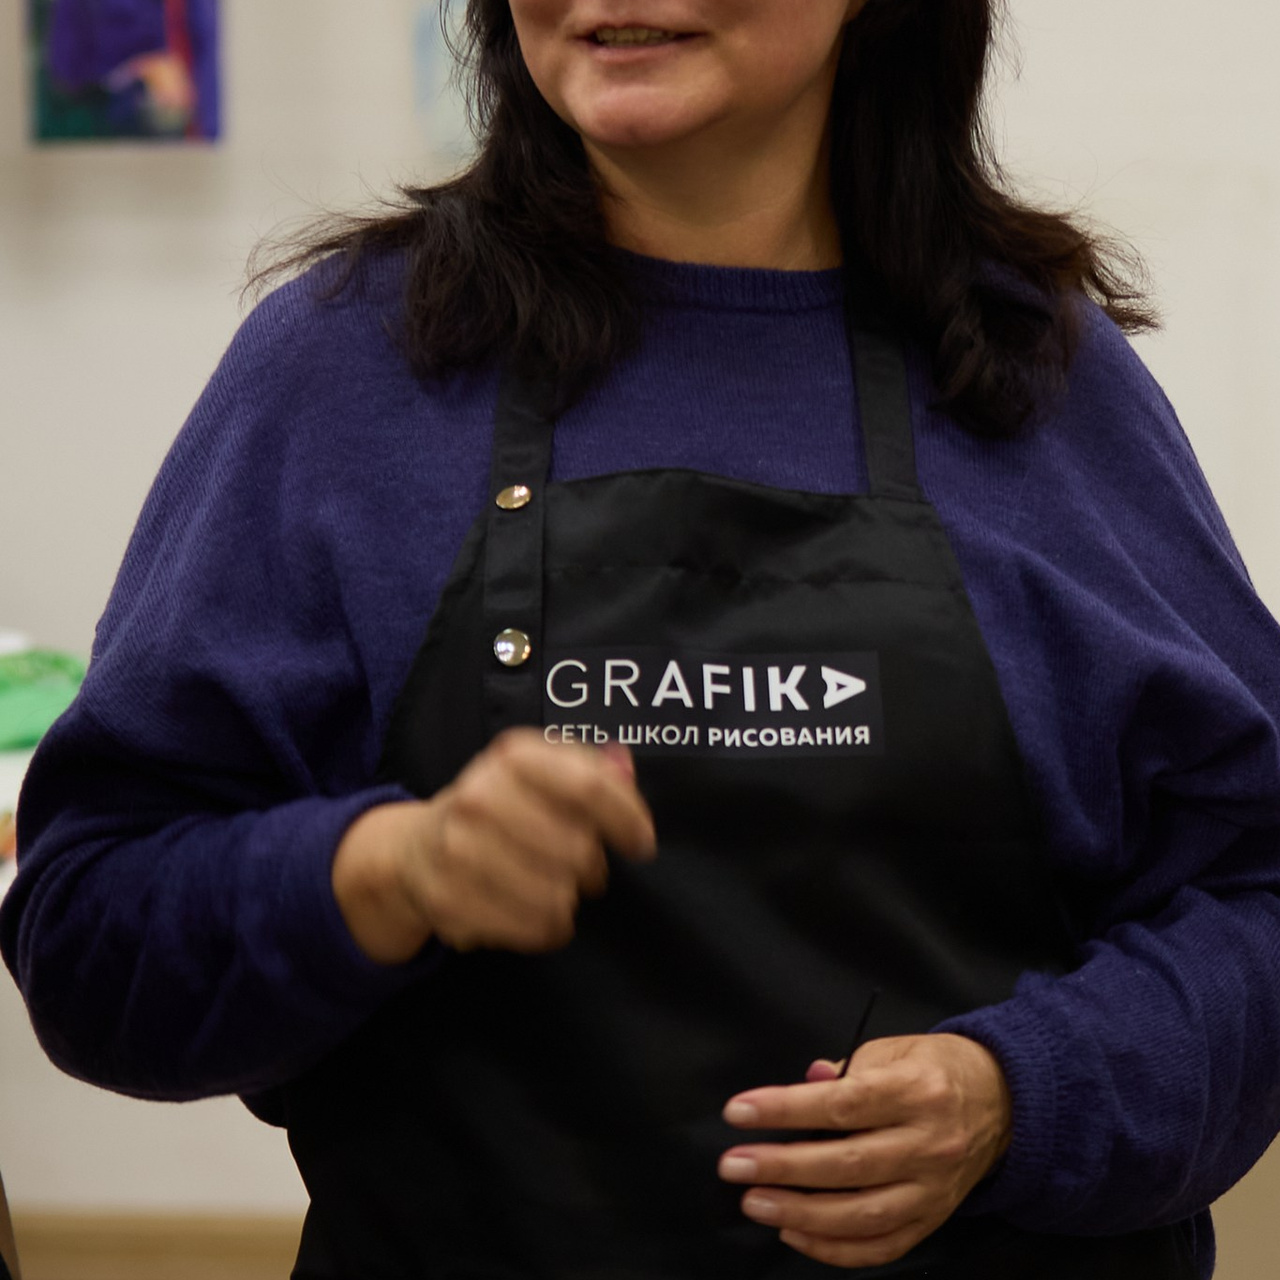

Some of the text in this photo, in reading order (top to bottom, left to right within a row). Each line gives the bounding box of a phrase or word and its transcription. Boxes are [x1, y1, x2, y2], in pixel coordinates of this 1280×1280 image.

[544, 724, 870, 747] СЕТЬ ШКОЛ РИСОВАНИЯ
